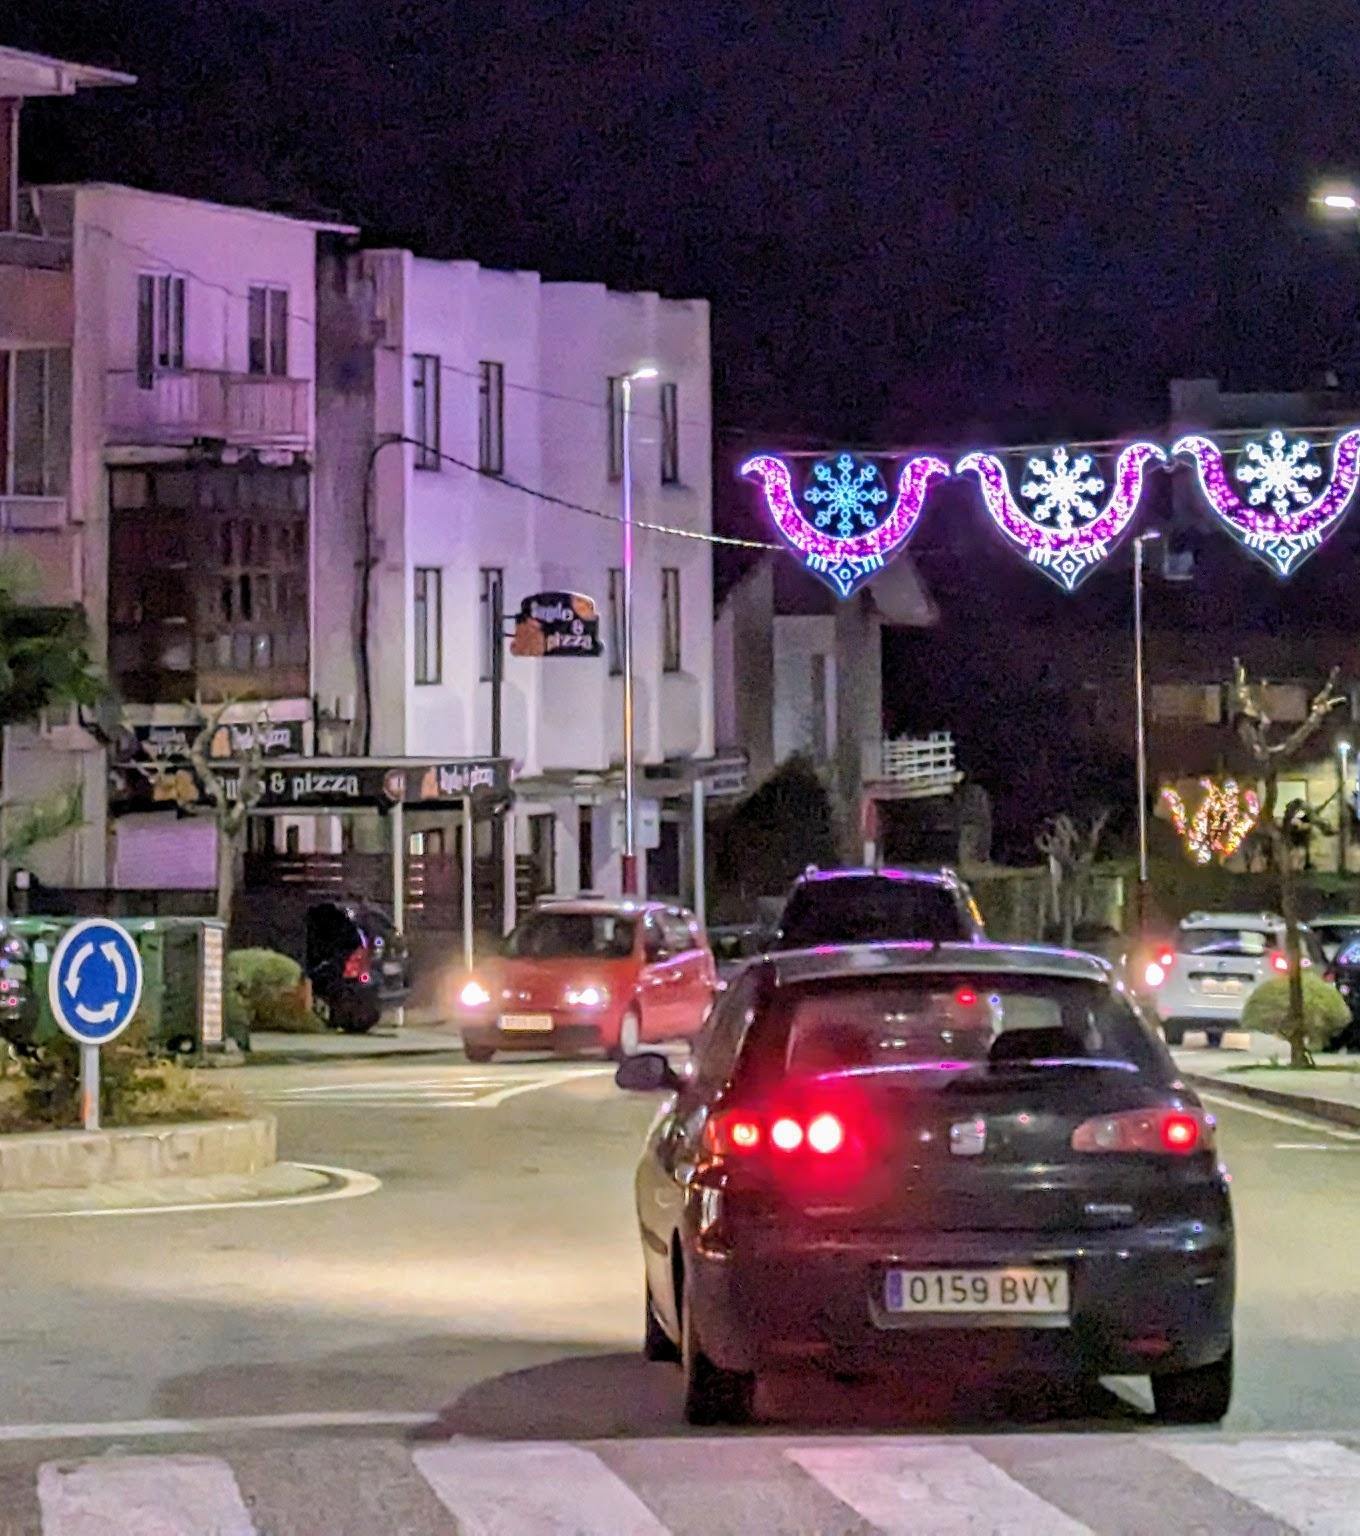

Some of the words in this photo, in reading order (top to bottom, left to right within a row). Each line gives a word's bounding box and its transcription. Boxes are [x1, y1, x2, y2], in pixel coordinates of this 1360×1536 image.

[545, 631, 593, 652] pizza
[270, 771, 286, 794] &
[292, 771, 360, 801] pizza
[909, 1275, 989, 1304] 0159
[999, 1275, 1059, 1305] BVY
